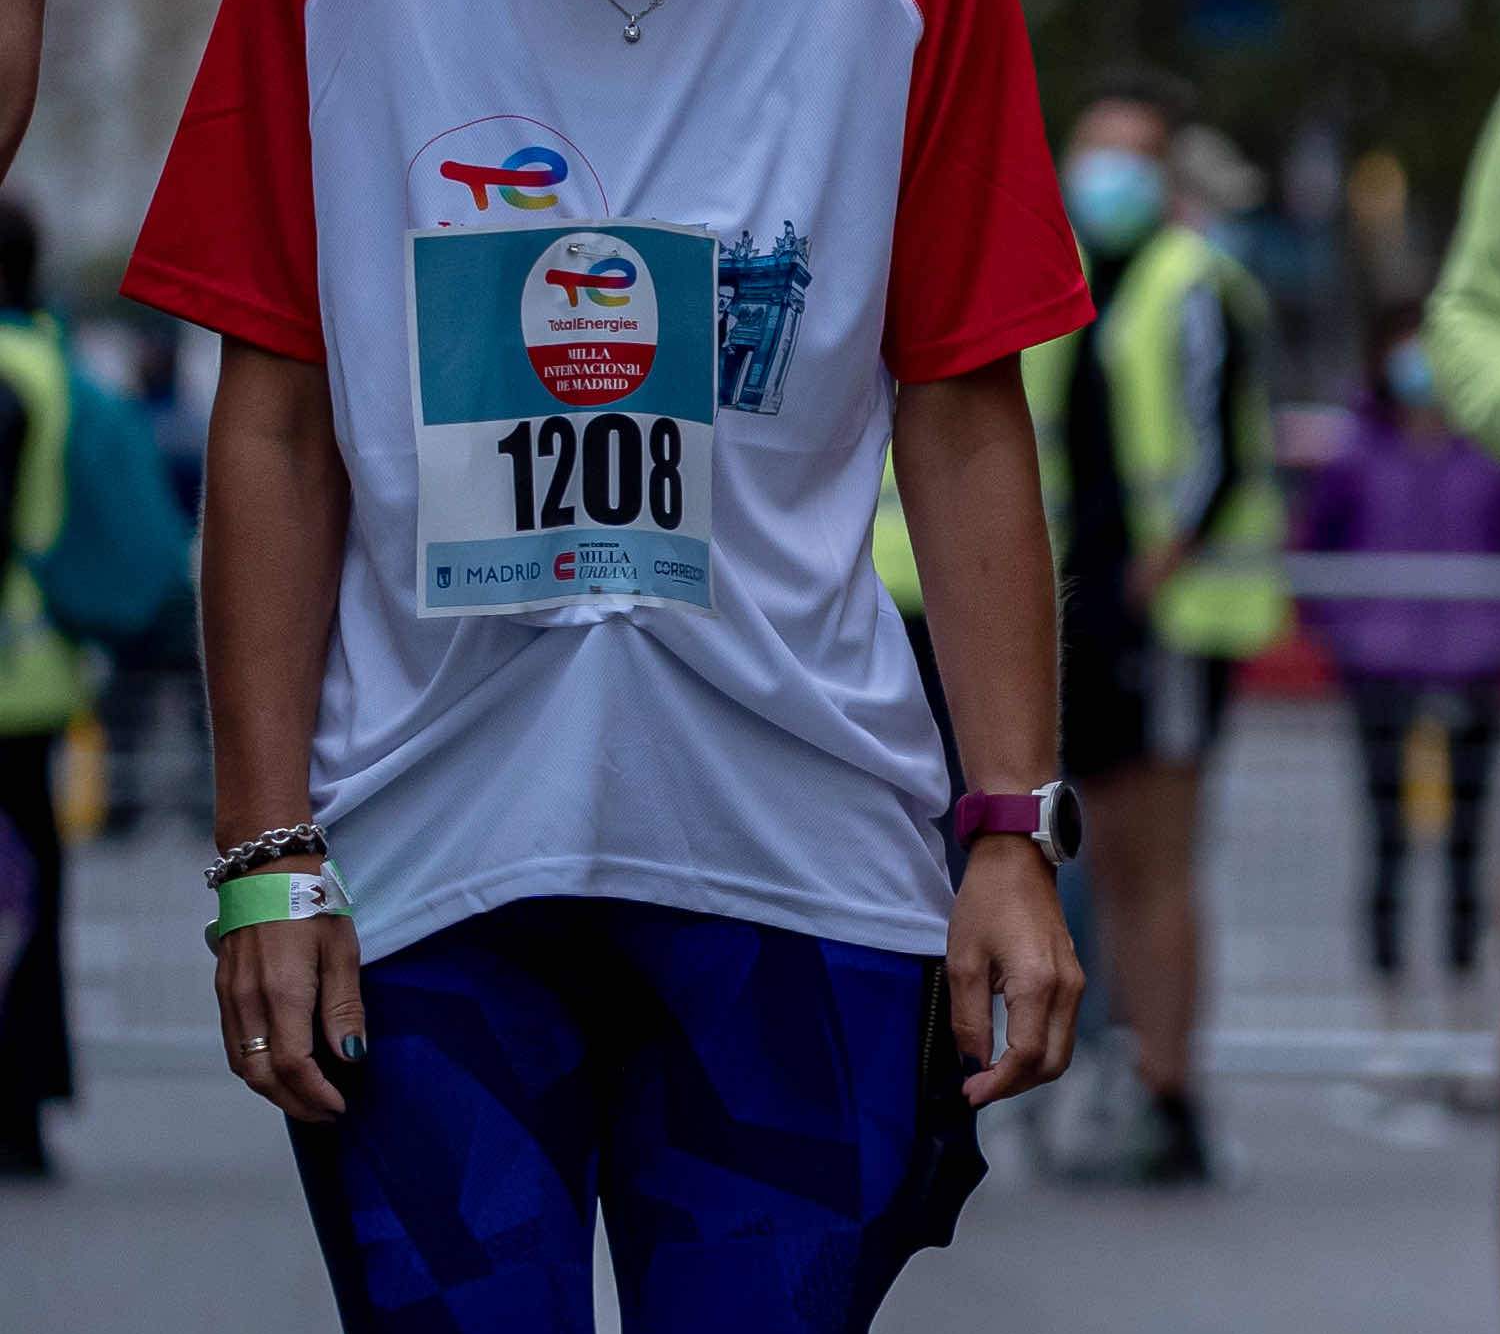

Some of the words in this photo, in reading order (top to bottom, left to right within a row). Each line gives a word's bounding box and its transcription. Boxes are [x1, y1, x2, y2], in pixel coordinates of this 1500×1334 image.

[548, 317, 639, 332] TotalEnergies
[567, 347, 612, 360] MILLA
[556, 379, 570, 392] DE
[572, 378, 629, 390] MADRID
[497, 412, 683, 532] 1208
[579, 550, 631, 564] MILLA
[466, 561, 541, 585] MADRID
[578, 565, 638, 580] URBANA
